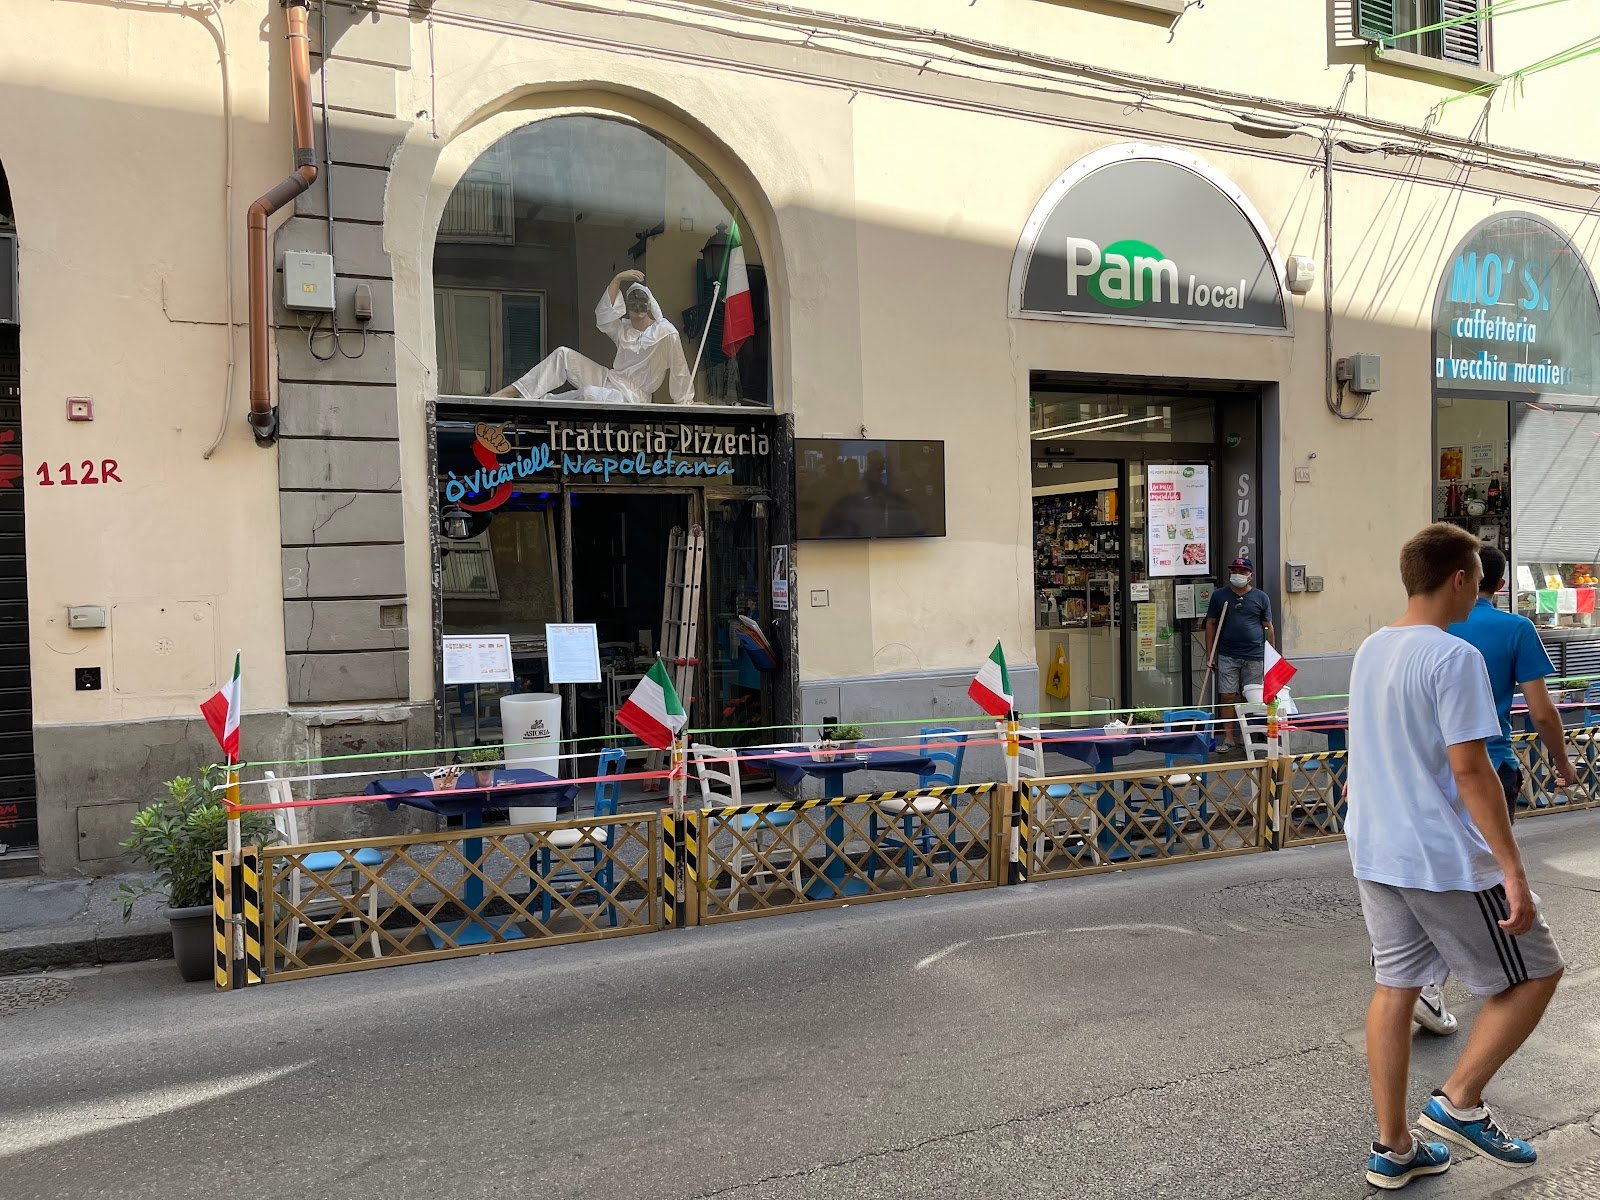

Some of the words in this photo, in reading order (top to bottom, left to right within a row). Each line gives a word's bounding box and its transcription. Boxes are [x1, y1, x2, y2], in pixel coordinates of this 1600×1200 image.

[1066, 237, 1180, 304] Pam
[1187, 274, 1246, 310] local
[1456, 309, 1537, 343] caffetteria
[1451, 351, 1507, 382] vecchia
[547, 420, 667, 452] Trattoria
[680, 423, 770, 456] Pizzeria
[36, 459, 123, 486] 112R
[562, 448, 735, 482] Napoletana
[523, 729, 550, 737] ASTORIA
